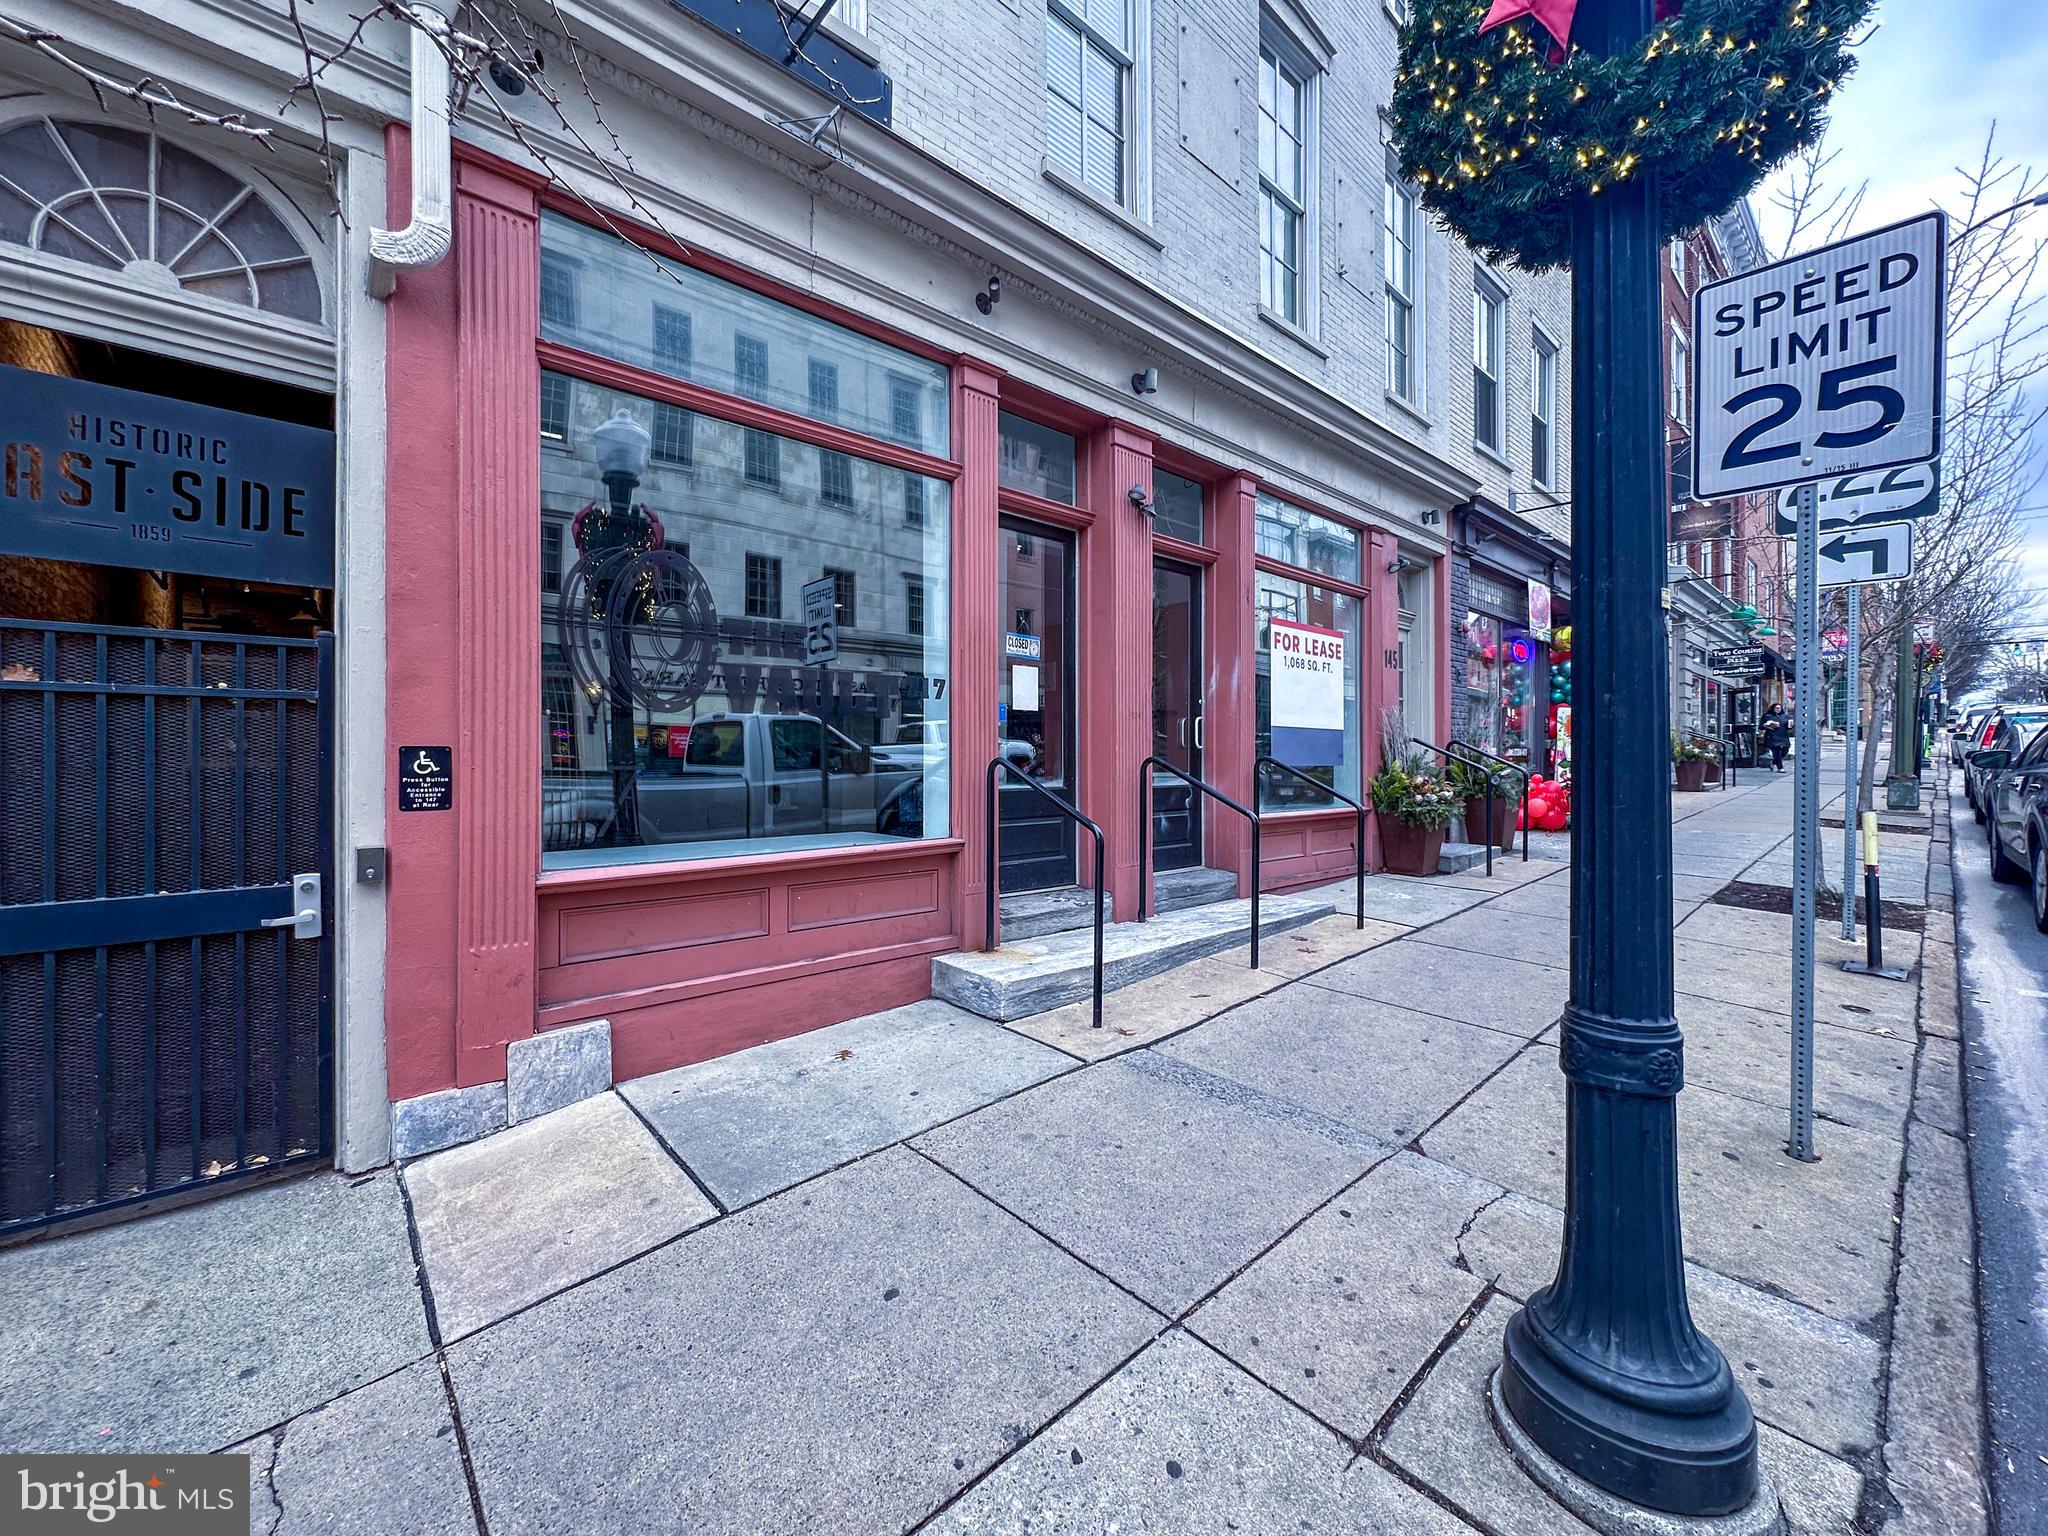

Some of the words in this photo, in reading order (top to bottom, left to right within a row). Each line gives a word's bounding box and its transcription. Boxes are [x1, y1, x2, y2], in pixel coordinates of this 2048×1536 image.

[1714, 252, 1919, 337] SPEED
[1734, 306, 1891, 379] LIMIT
[1720, 354, 1906, 471] 25
[69, 413, 229, 465] HISTORIC
[171, 469, 306, 538] SIDE
[130, 523, 172, 543] 1859
[1007, 636, 1029, 650] CLOSED
[1274, 631, 1301, 654] FOR
[1304, 637, 1342, 661] LEASE
[1384, 649, 1398, 670] 145
[1283, 655, 1305, 669] 1,068
[1307, 659, 1320, 672] SQ.
[1322, 663, 1333, 674] FT.
